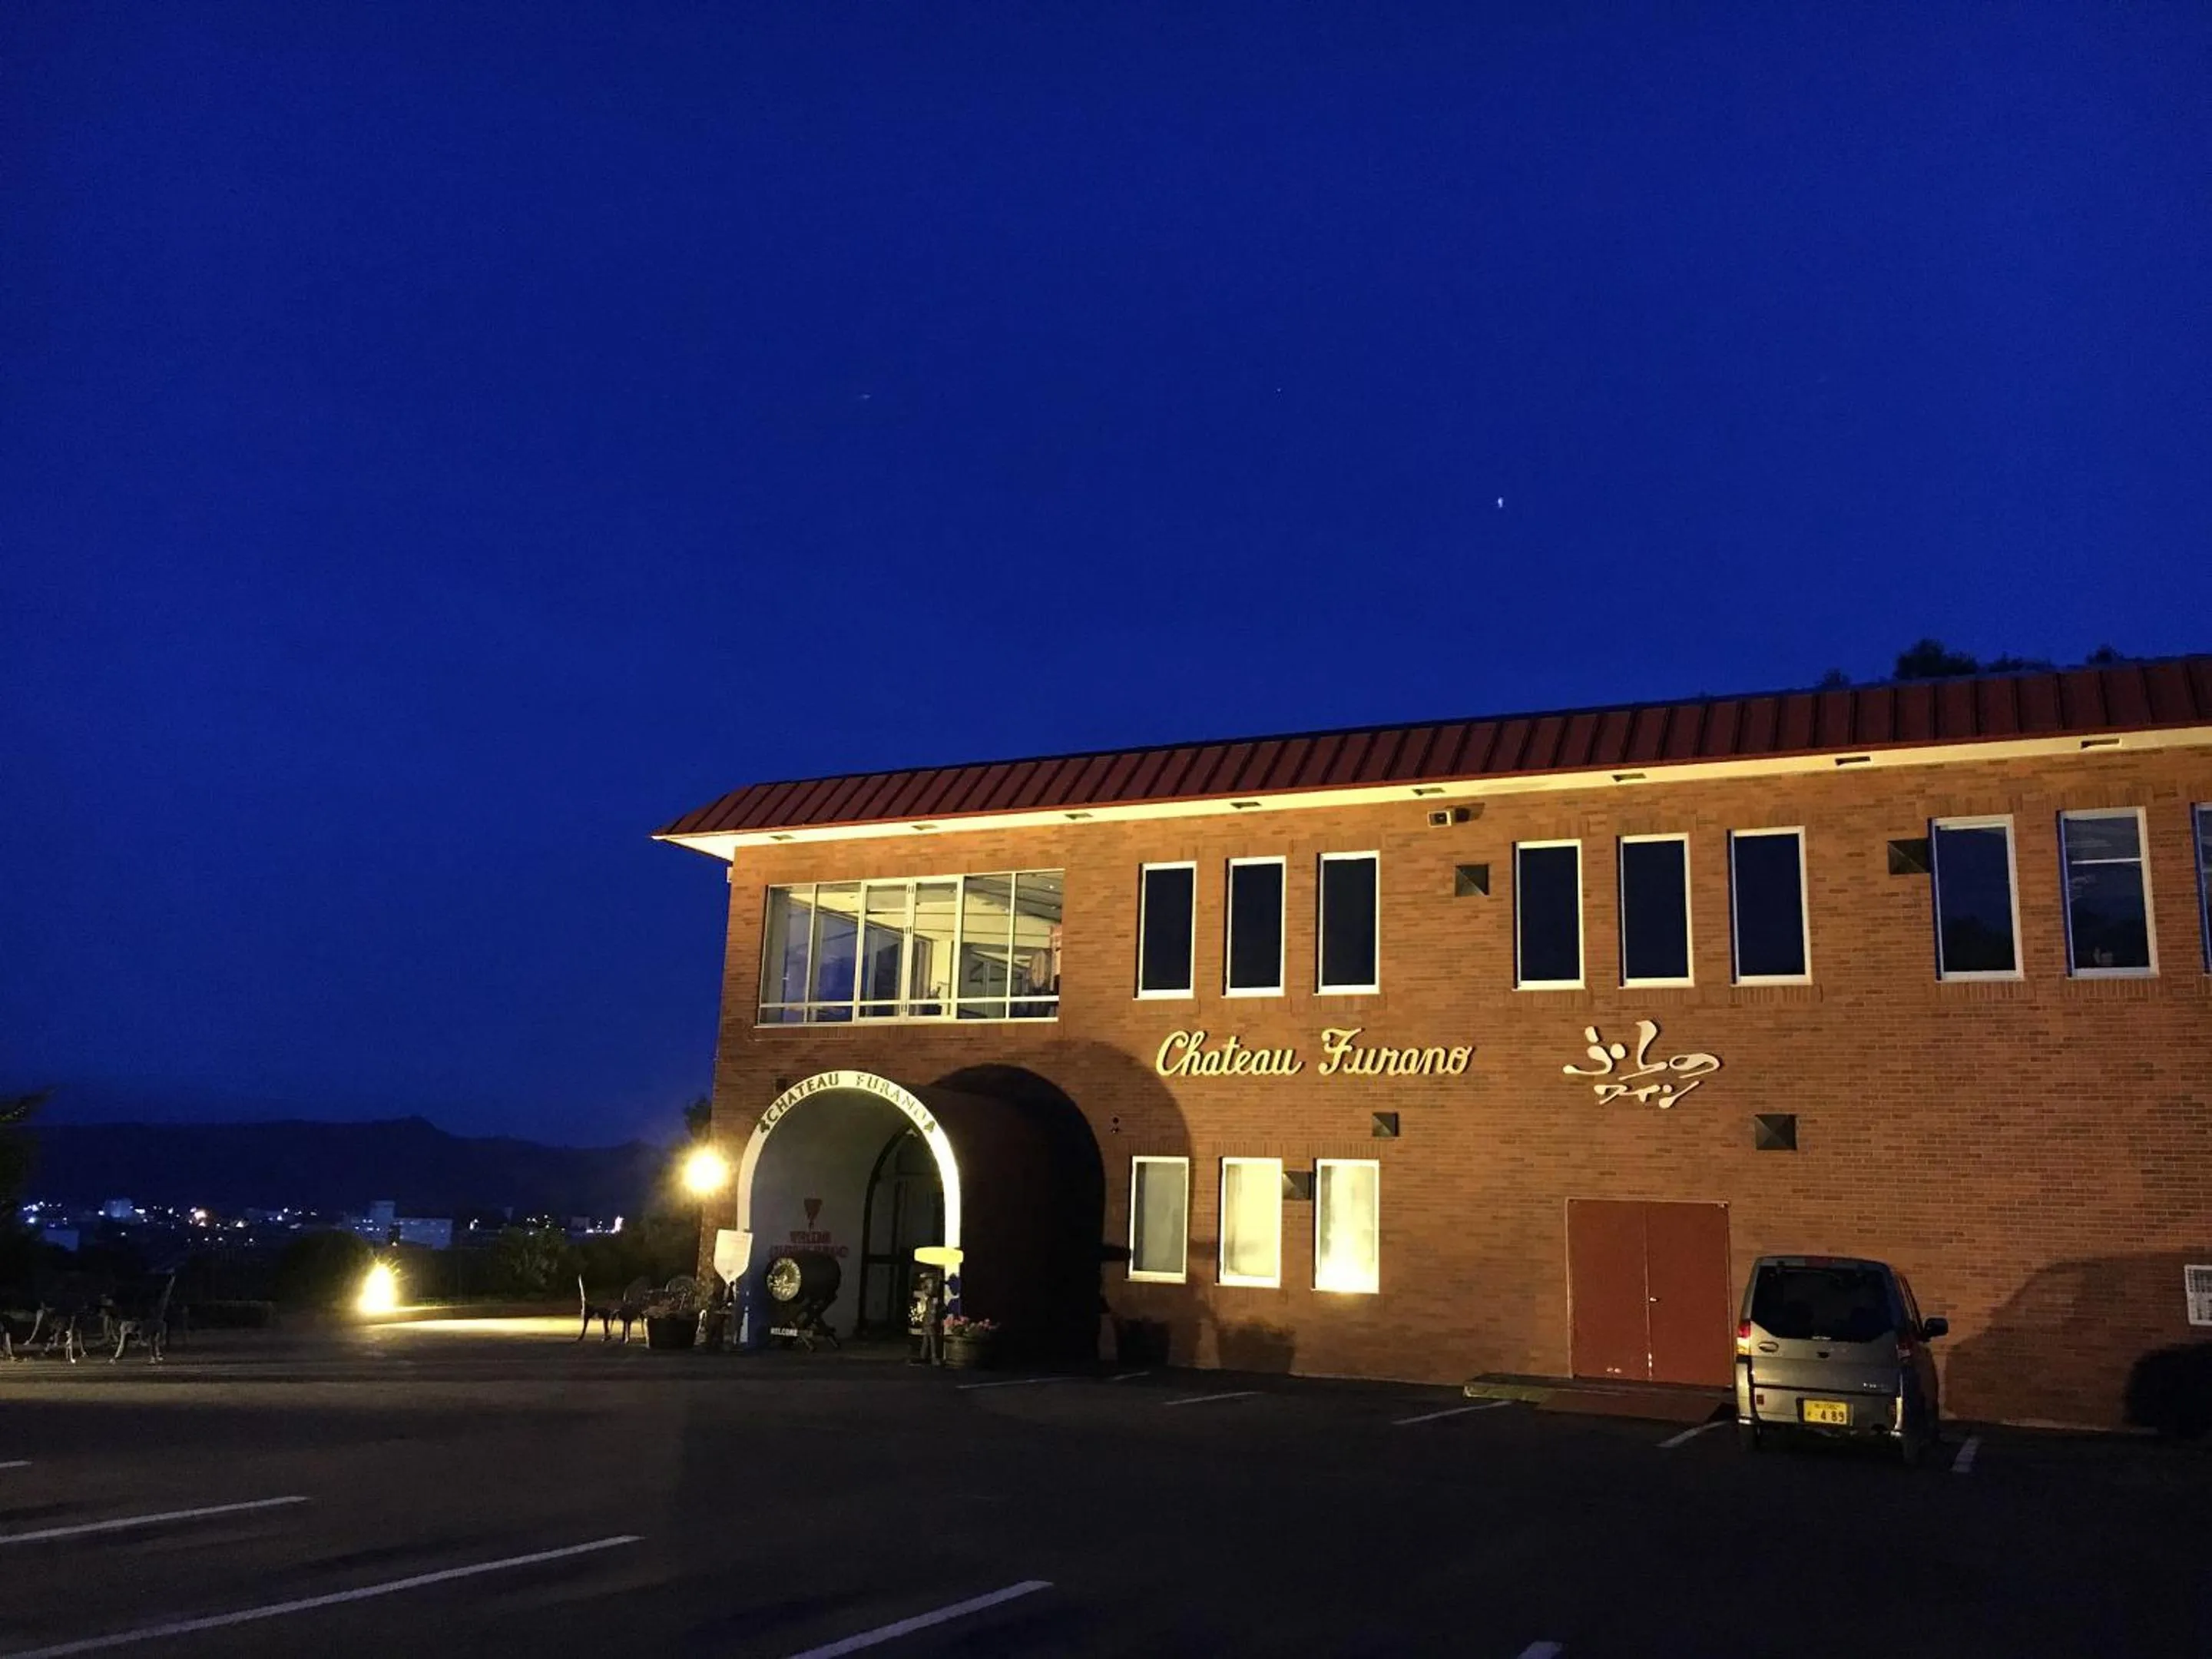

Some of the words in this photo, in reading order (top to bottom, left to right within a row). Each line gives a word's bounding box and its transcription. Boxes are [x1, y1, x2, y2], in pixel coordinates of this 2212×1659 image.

[1155, 1029, 1304, 1076] Chateau
[1318, 1027, 1473, 1076] Furano
[769, 1073, 839, 1123] CHATEAU
[856, 1074, 926, 1121] FURANO
